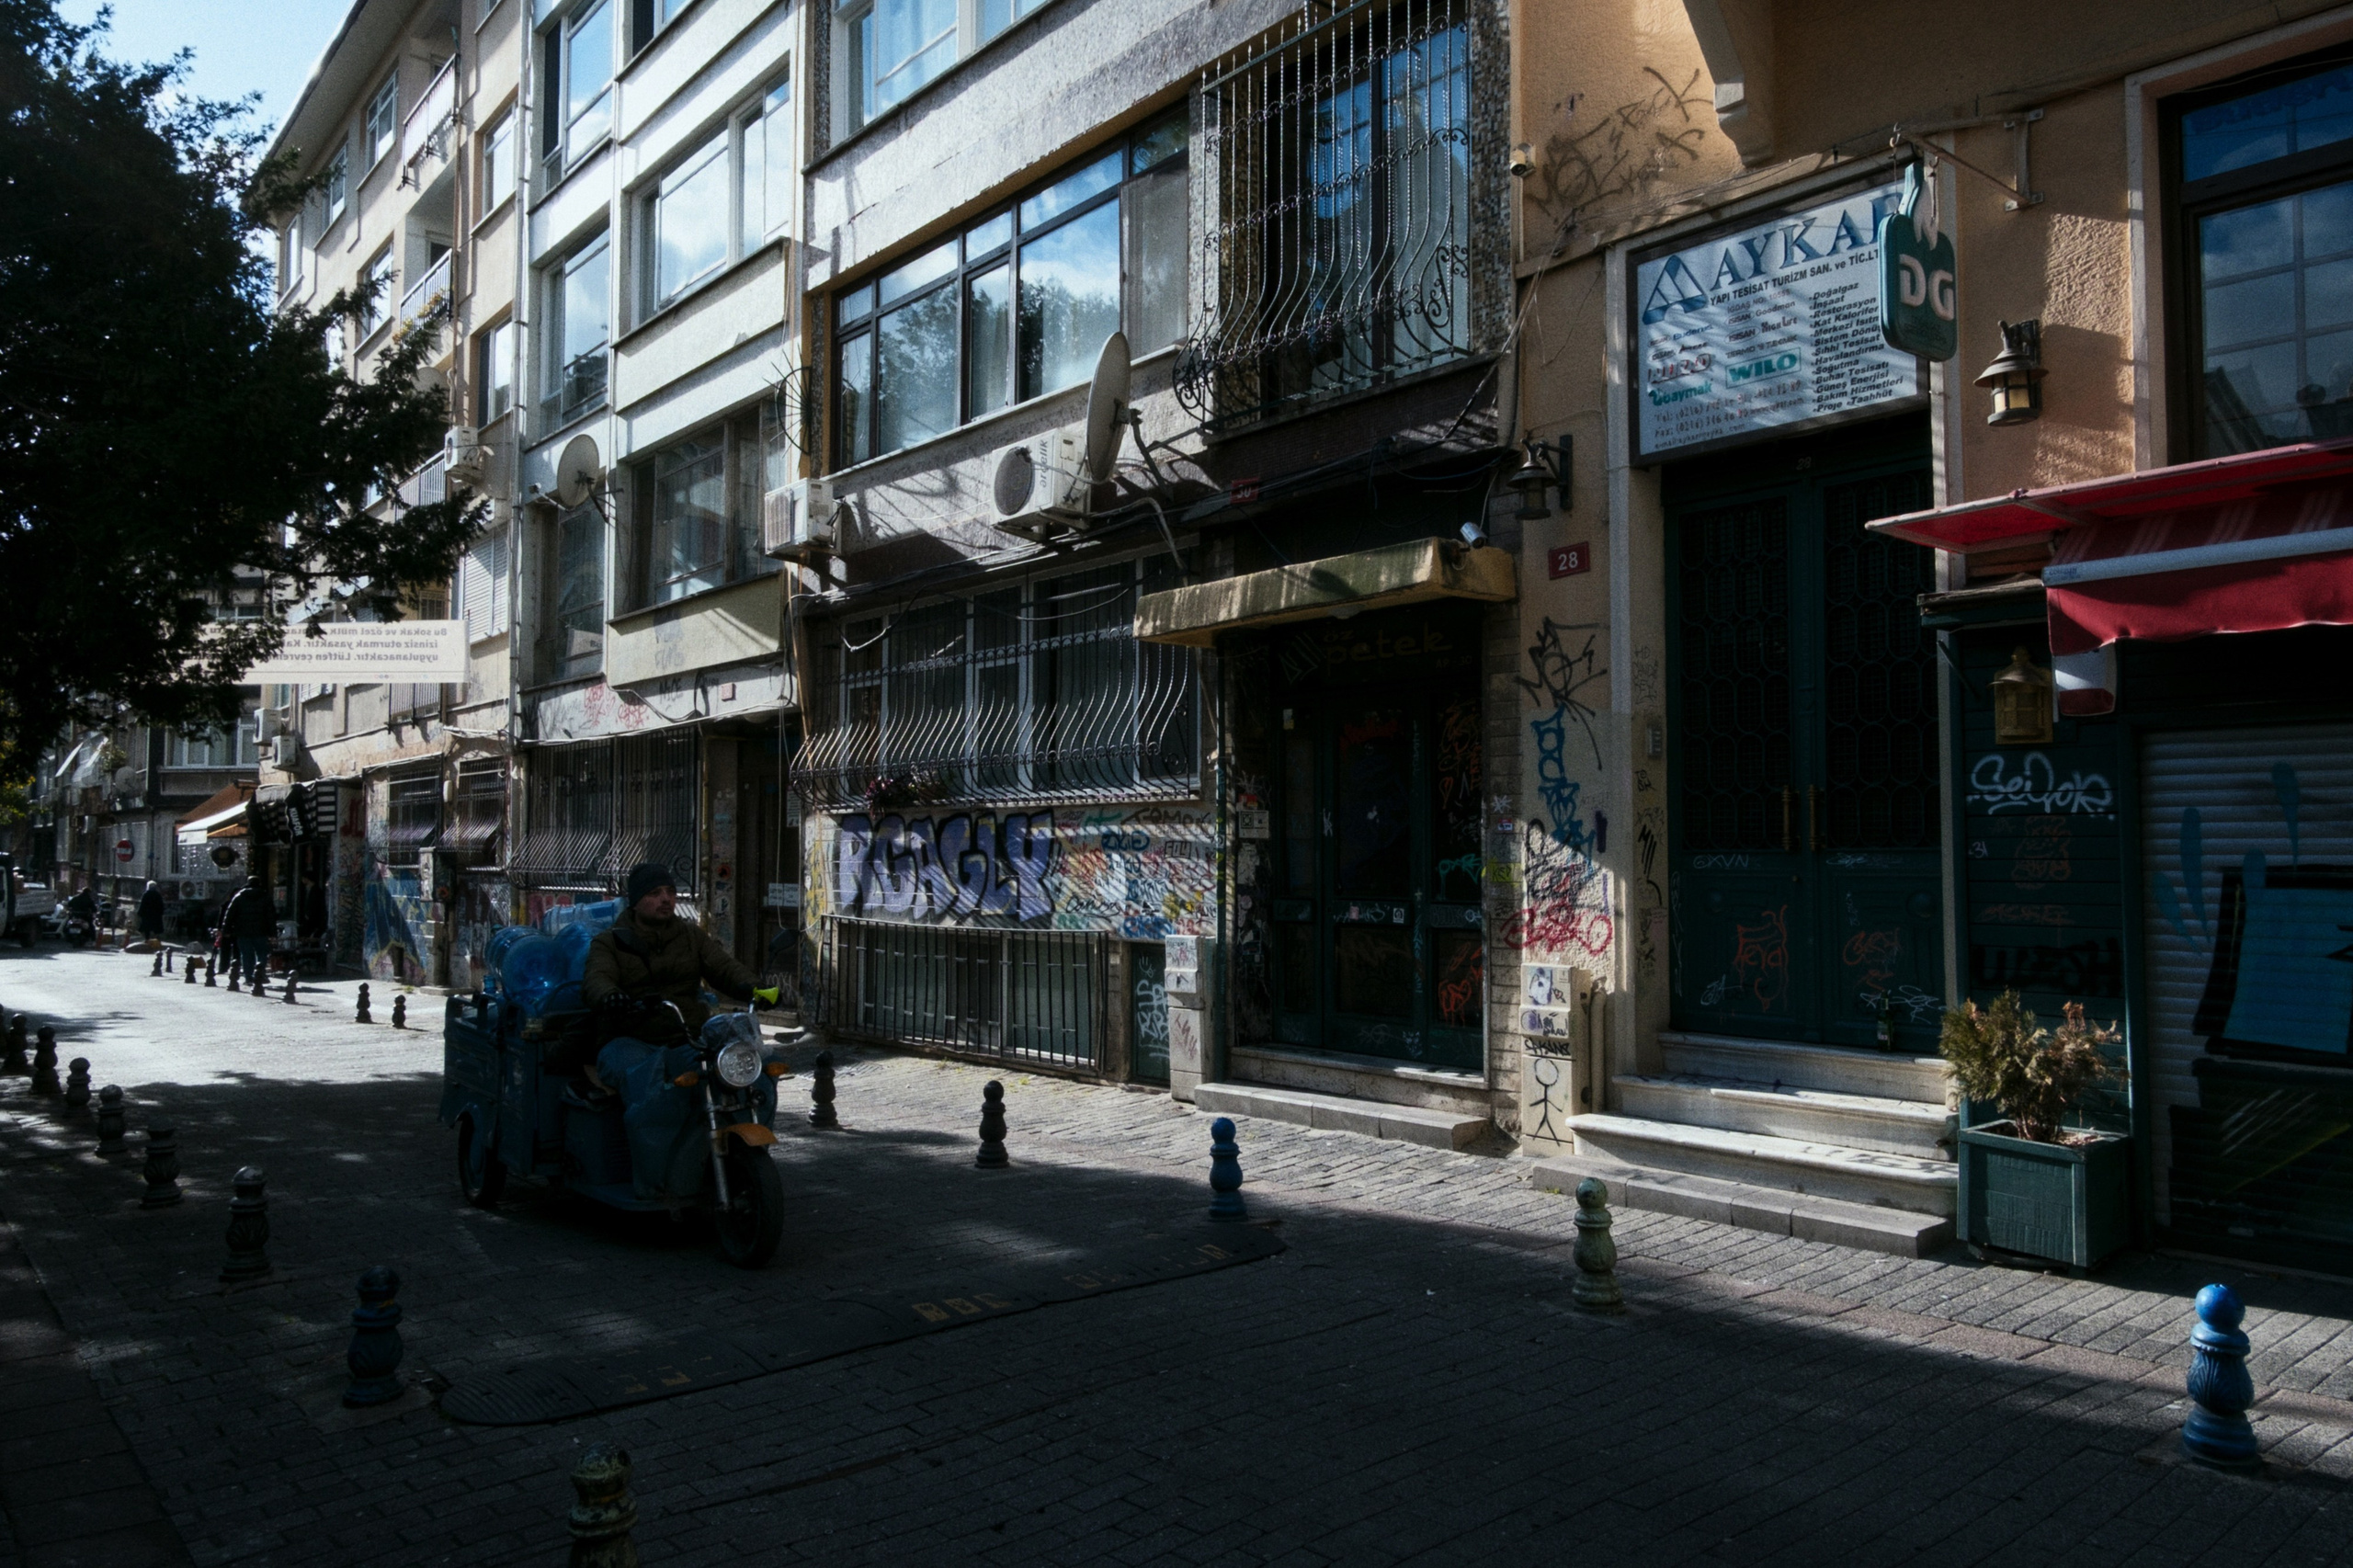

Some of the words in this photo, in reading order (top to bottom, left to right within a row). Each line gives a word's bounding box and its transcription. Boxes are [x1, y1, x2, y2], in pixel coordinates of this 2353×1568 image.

[1710, 291, 1731, 307] YAPI
[1732, 279, 1770, 301] TESİSAT
[1772, 268, 1808, 292] TURİZM
[1809, 263, 1833, 278] SAN.
[1835, 260, 1847, 270] ve
[1813, 282, 1859, 301] Doğalgaz
[1899, 253, 1954, 322] DG
[1755, 301, 1796, 317] Goodman
[1813, 295, 1846, 310] İnşaat
[1813, 297, 1877, 319] Restorasyon
[1813, 317, 1832, 328] Kat
[1834, 305, 1879, 323] Kalorifer
[1813, 321, 1853, 338] Merkezi
[1813, 332, 1849, 347] Sistem
[1814, 345, 1839, 357] Sıhhi
[1842, 333, 1881, 347] Tesisat
[1814, 343, 1885, 366] Havalandırma
[1729, 353, 1798, 383] WILO
[1814, 358, 1859, 376] Soğutma
[1815, 372, 1846, 384] Buhar
[1847, 361, 1889, 374] Tesisatı
[1816, 381, 1847, 394] Güneş
[1850, 369, 1889, 386] Enerjisi
[1816, 391, 1847, 403] Bakım
[1850, 375, 1904, 395] Hizmetleri
[1816, 401, 1843, 413] Proje
[1850, 389, 1893, 405] Taahhüt
[1039, 439, 1050, 489] arelik
[1795, 456, 1813, 471] 28
[1558, 551, 1578, 572] 28
[1325, 619, 1454, 677] petek
